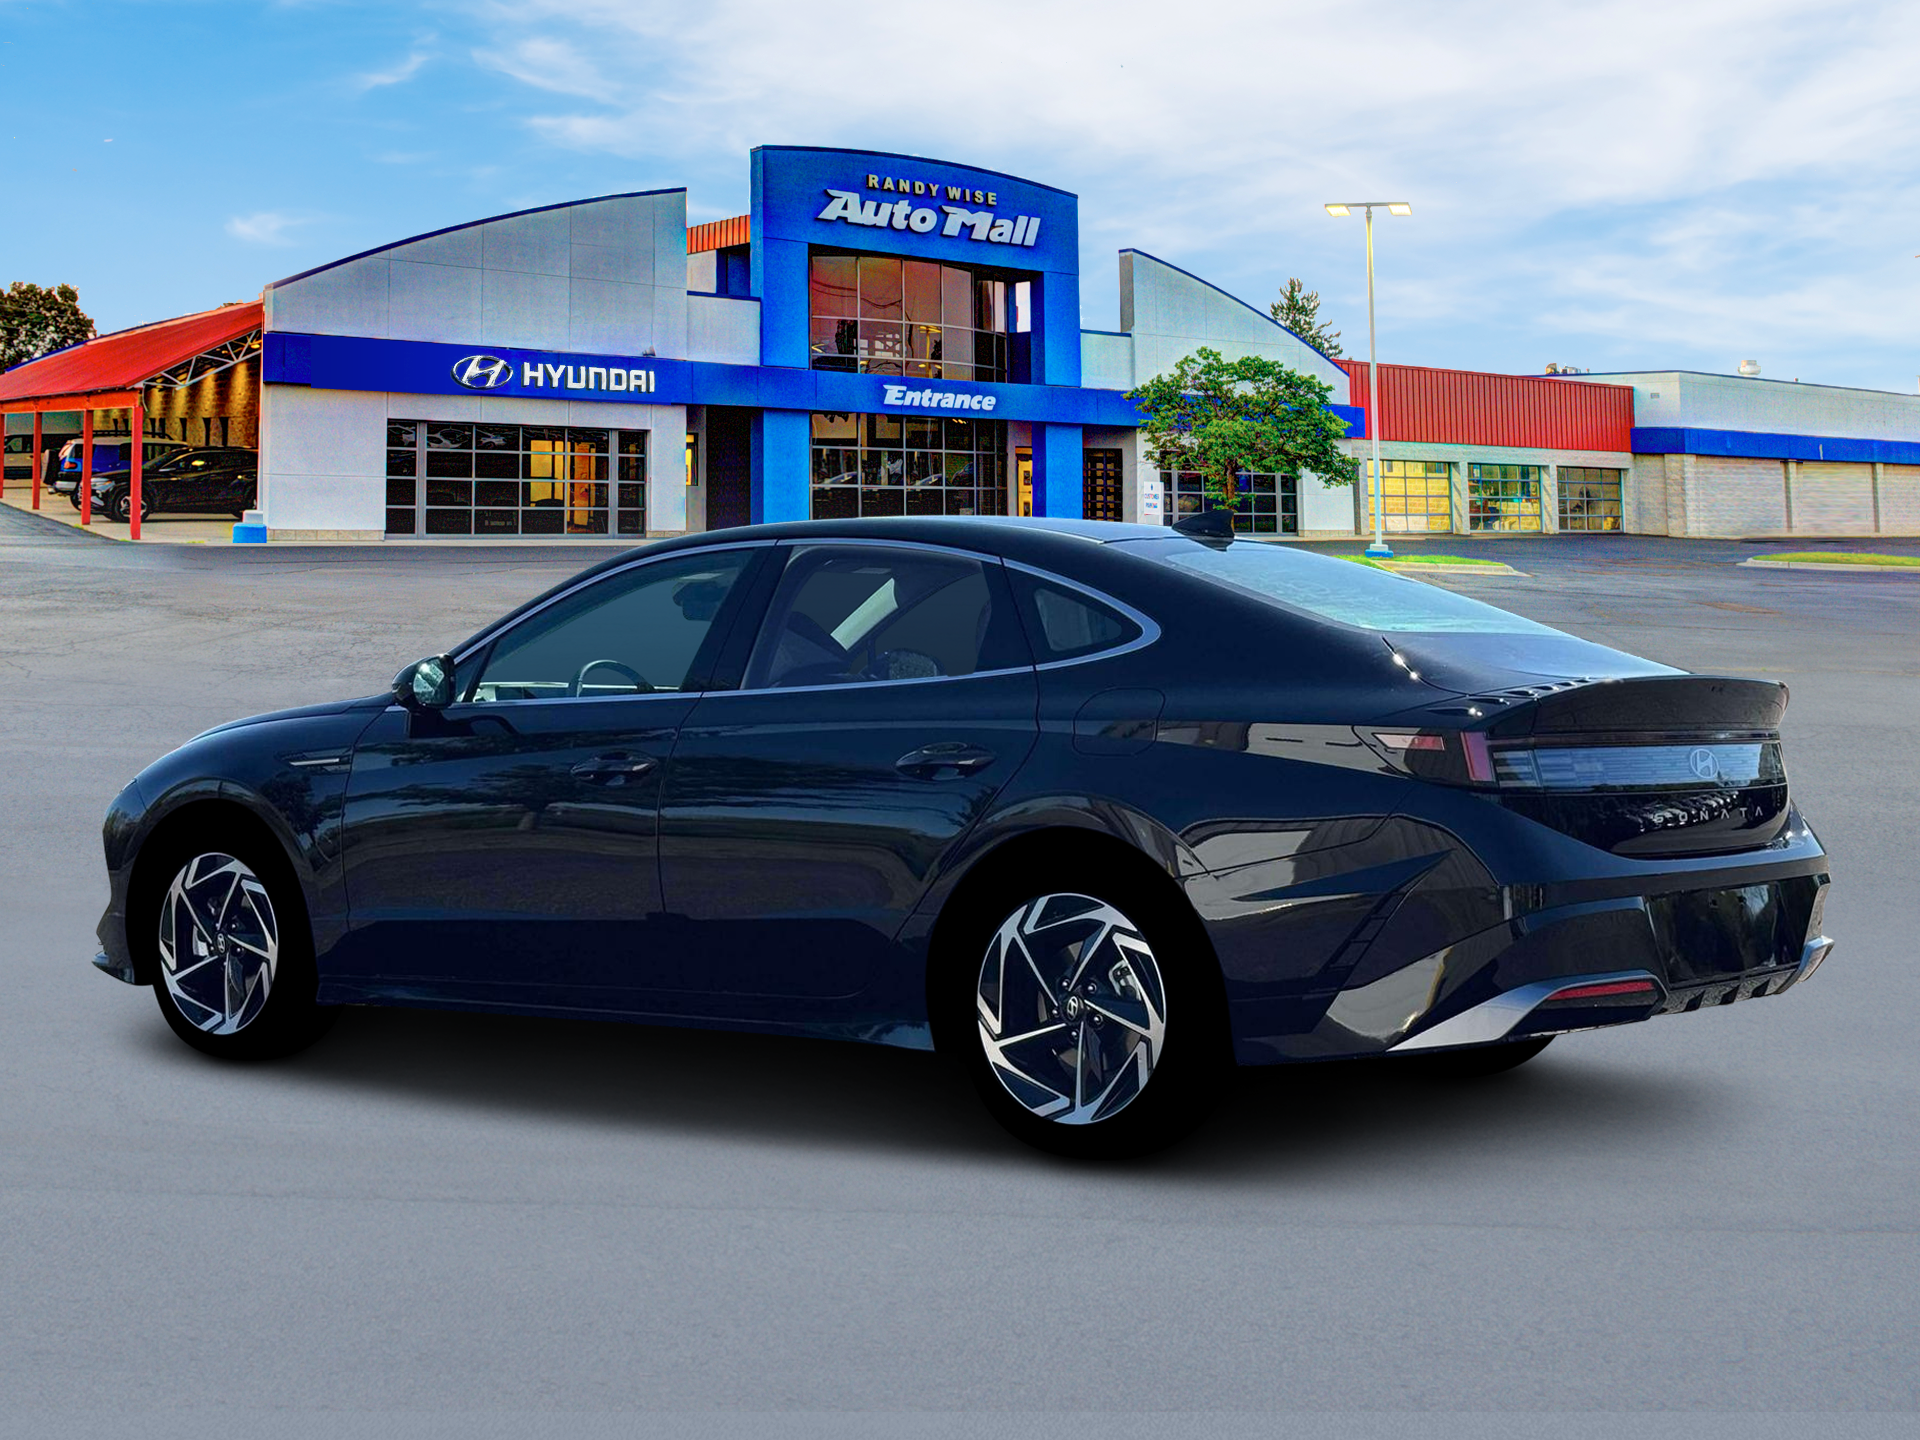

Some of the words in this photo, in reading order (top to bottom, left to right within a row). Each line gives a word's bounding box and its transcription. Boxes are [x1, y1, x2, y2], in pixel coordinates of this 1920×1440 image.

[867, 174, 939, 197] RANDY
[946, 186, 997, 206] WISE
[817, 189, 938, 233] Auto
[941, 205, 1041, 247] Mall
[522, 362, 655, 393] HYUNDAI
[882, 384, 996, 411] Entrance
